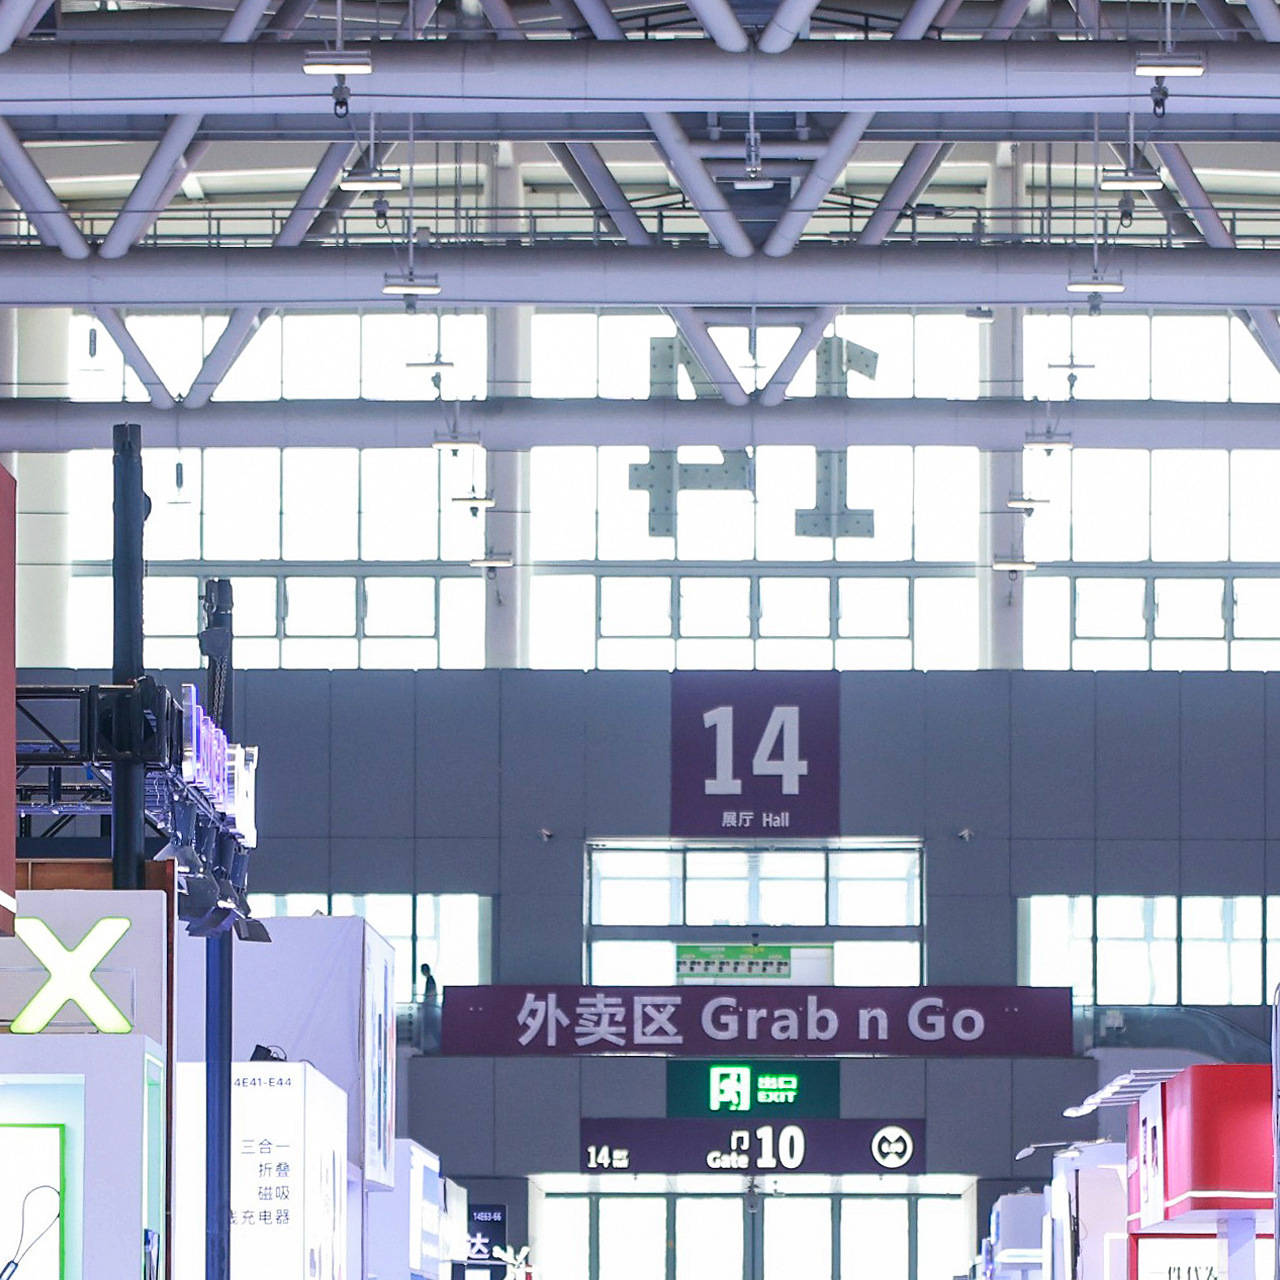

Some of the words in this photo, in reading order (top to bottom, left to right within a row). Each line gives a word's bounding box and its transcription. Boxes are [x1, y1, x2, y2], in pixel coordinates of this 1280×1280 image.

[702, 706, 807, 795] 14
[721, 811, 754, 828] 展厅
[761, 811, 790, 828] Hall
[517, 993, 684, 1047] 外卖区
[701, 996, 838, 1042] Grab
[859, 1006, 889, 1041] n
[907, 998, 985, 1042] Go
[233, 1077, 292, 1088] 4E41-E44
[757, 1074, 798, 1090] 出口
[757, 1090, 798, 1103] EXIT
[241, 1138, 291, 1155] 三合一
[706, 1151, 750, 1169] Gate
[755, 1125, 805, 1169] 10
[586, 1145, 611, 1169] 14
[258, 1162, 291, 1178] 折叠
[258, 1185, 291, 1201] 磁吸
